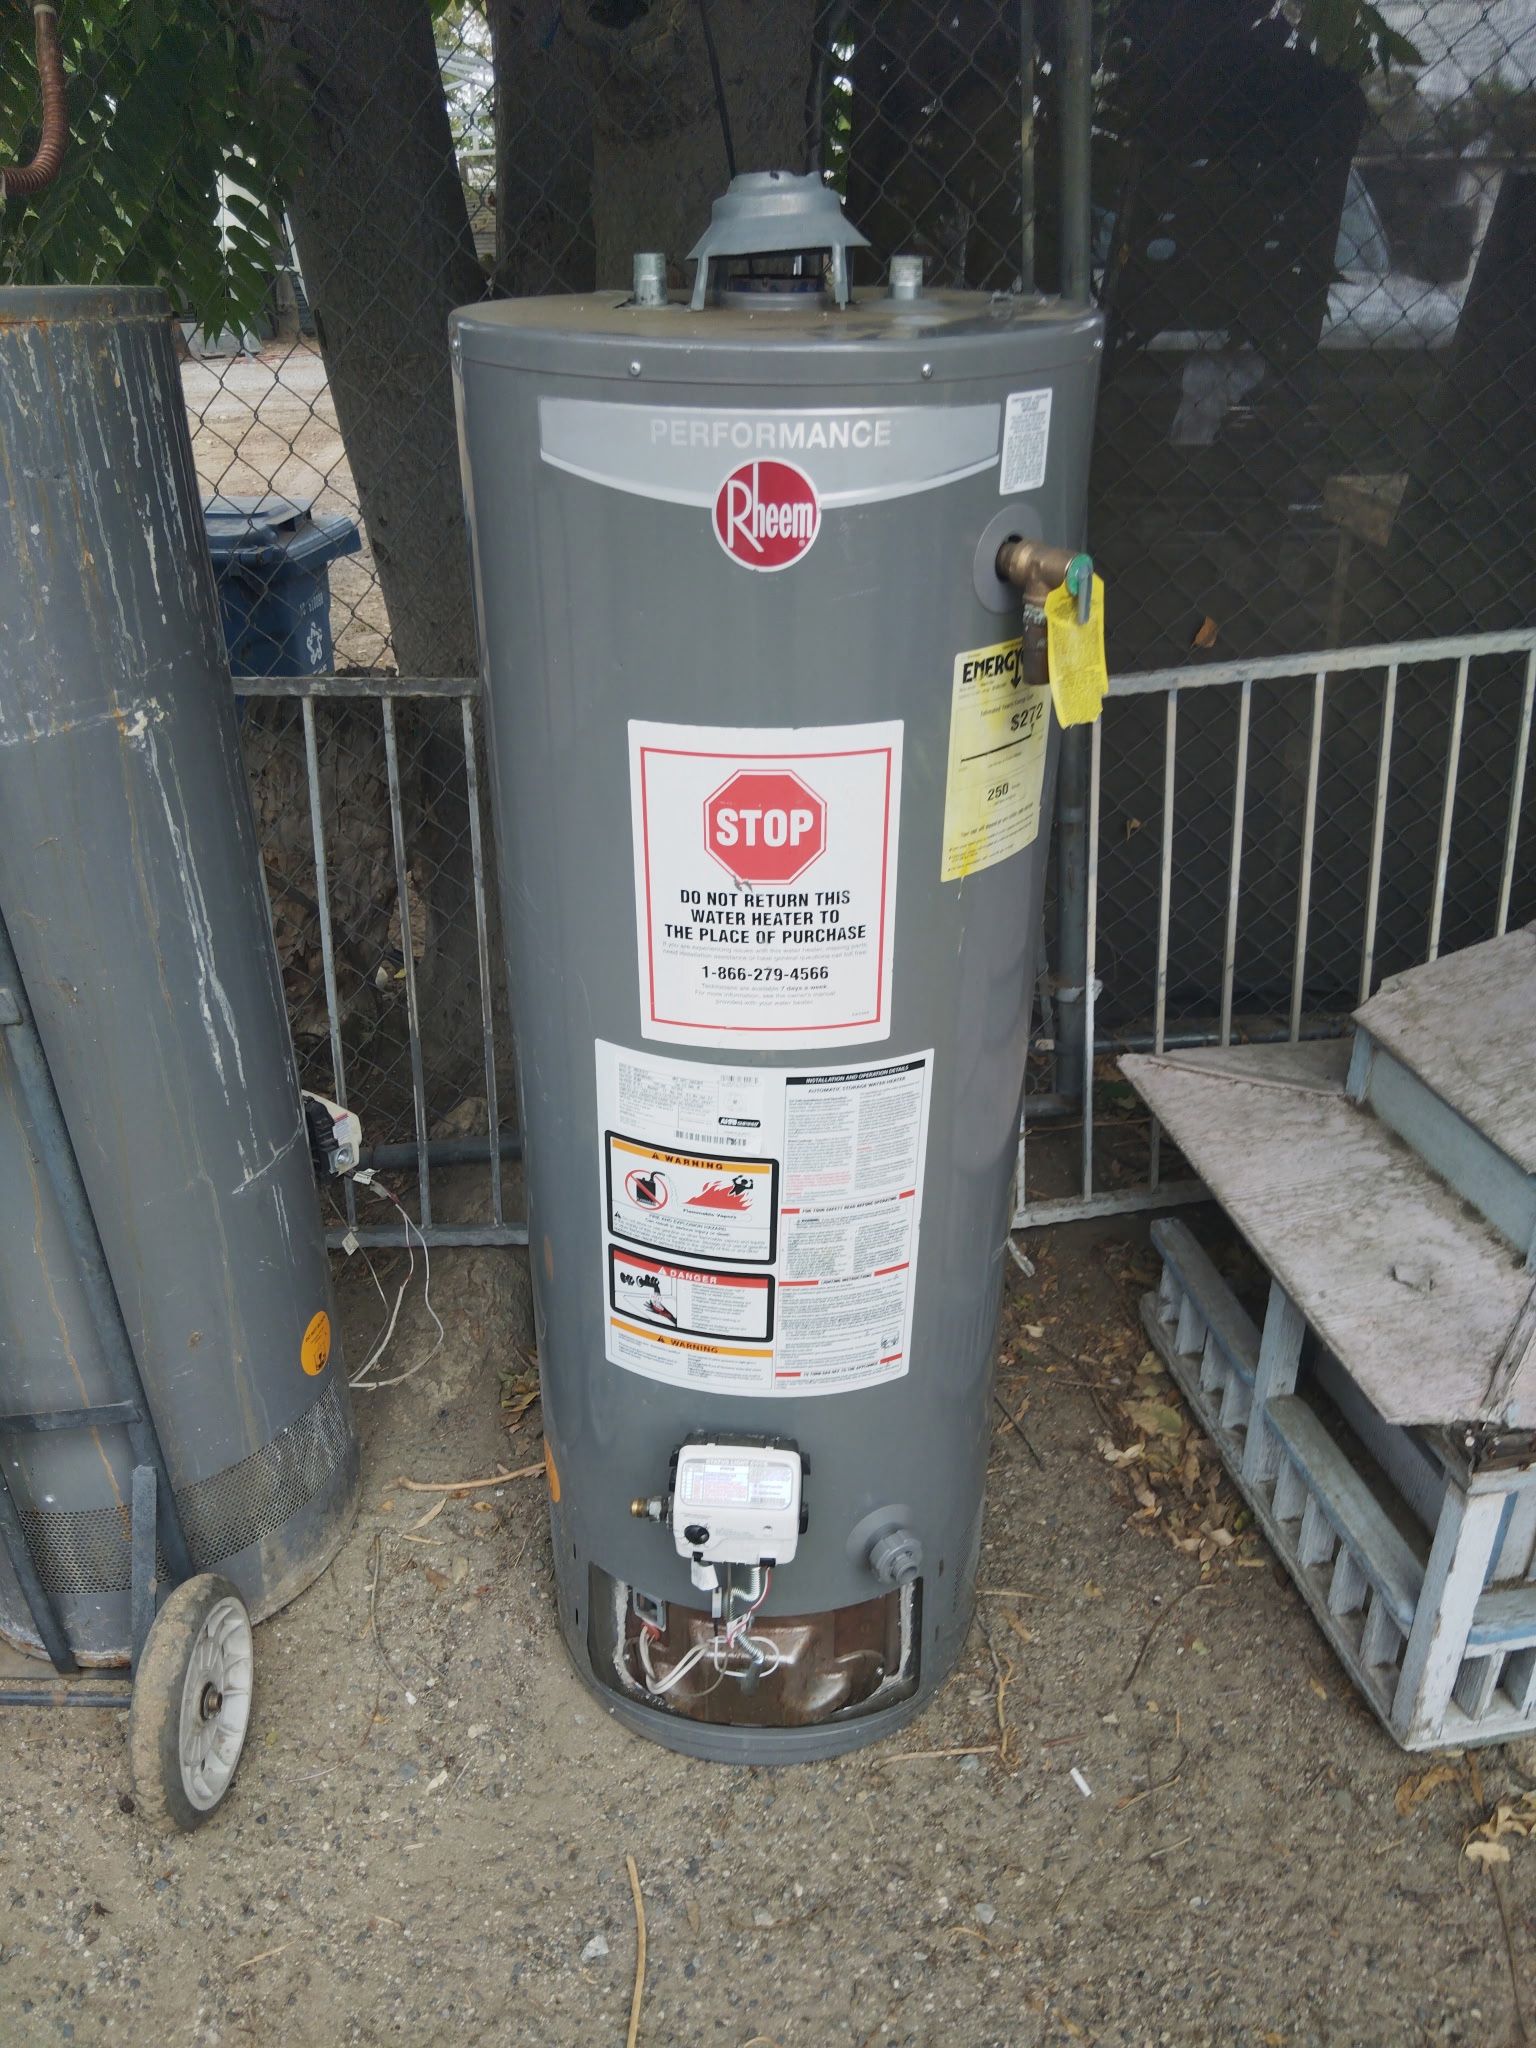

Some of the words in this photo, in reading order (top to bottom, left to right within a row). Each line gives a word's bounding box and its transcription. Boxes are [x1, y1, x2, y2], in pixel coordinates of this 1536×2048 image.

[650, 419, 893, 450] PERFORMANCE
[727, 462, 814, 553] Rheem
[986, 782, 1009, 801] 250
[716, 808, 814, 847] STOP
[680, 889, 701, 905] DO
[707, 892, 738, 907] NOT
[744, 893, 809, 908] RETURN
[815, 890, 851, 906] THIS
[691, 909, 746, 925] WATER
[752, 911, 814, 926] HEATER
[819, 910, 840, 924] TO
[664, 924, 694, 940] THE
[699, 927, 750, 944] PLACE
[756, 930, 776, 944] OF
[783, 925, 867, 944] PURCHASE
[702, 965, 829, 981] 1-866-279-4566
[665, 1154, 723, 1170] WARNING
[670, 1269, 718, 1285] DANGER
[670, 1339, 719, 1354] WARNING
